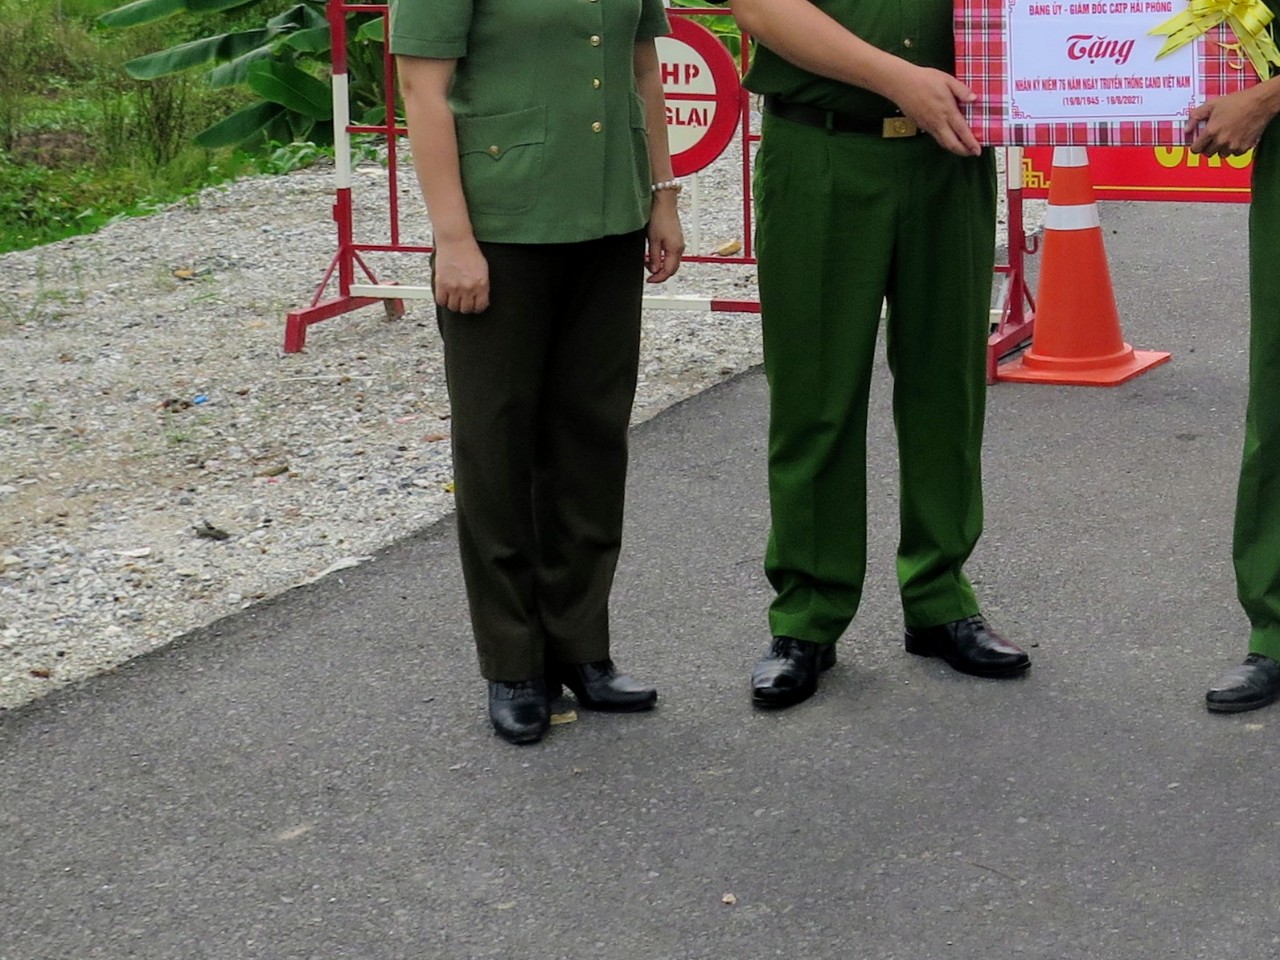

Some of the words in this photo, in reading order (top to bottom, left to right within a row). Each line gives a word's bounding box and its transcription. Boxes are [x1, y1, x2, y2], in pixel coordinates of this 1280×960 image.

[1092, 0, 1107, 14] ĐỐC
[1109, 3, 1128, 13] CATP
[1130, 0, 1143, 13] HẢI
[1145, 0, 1172, 13] PHÒNG
[1066, 35, 1136, 65] Tặng
[1176, 76, 1191, 89] NAM
